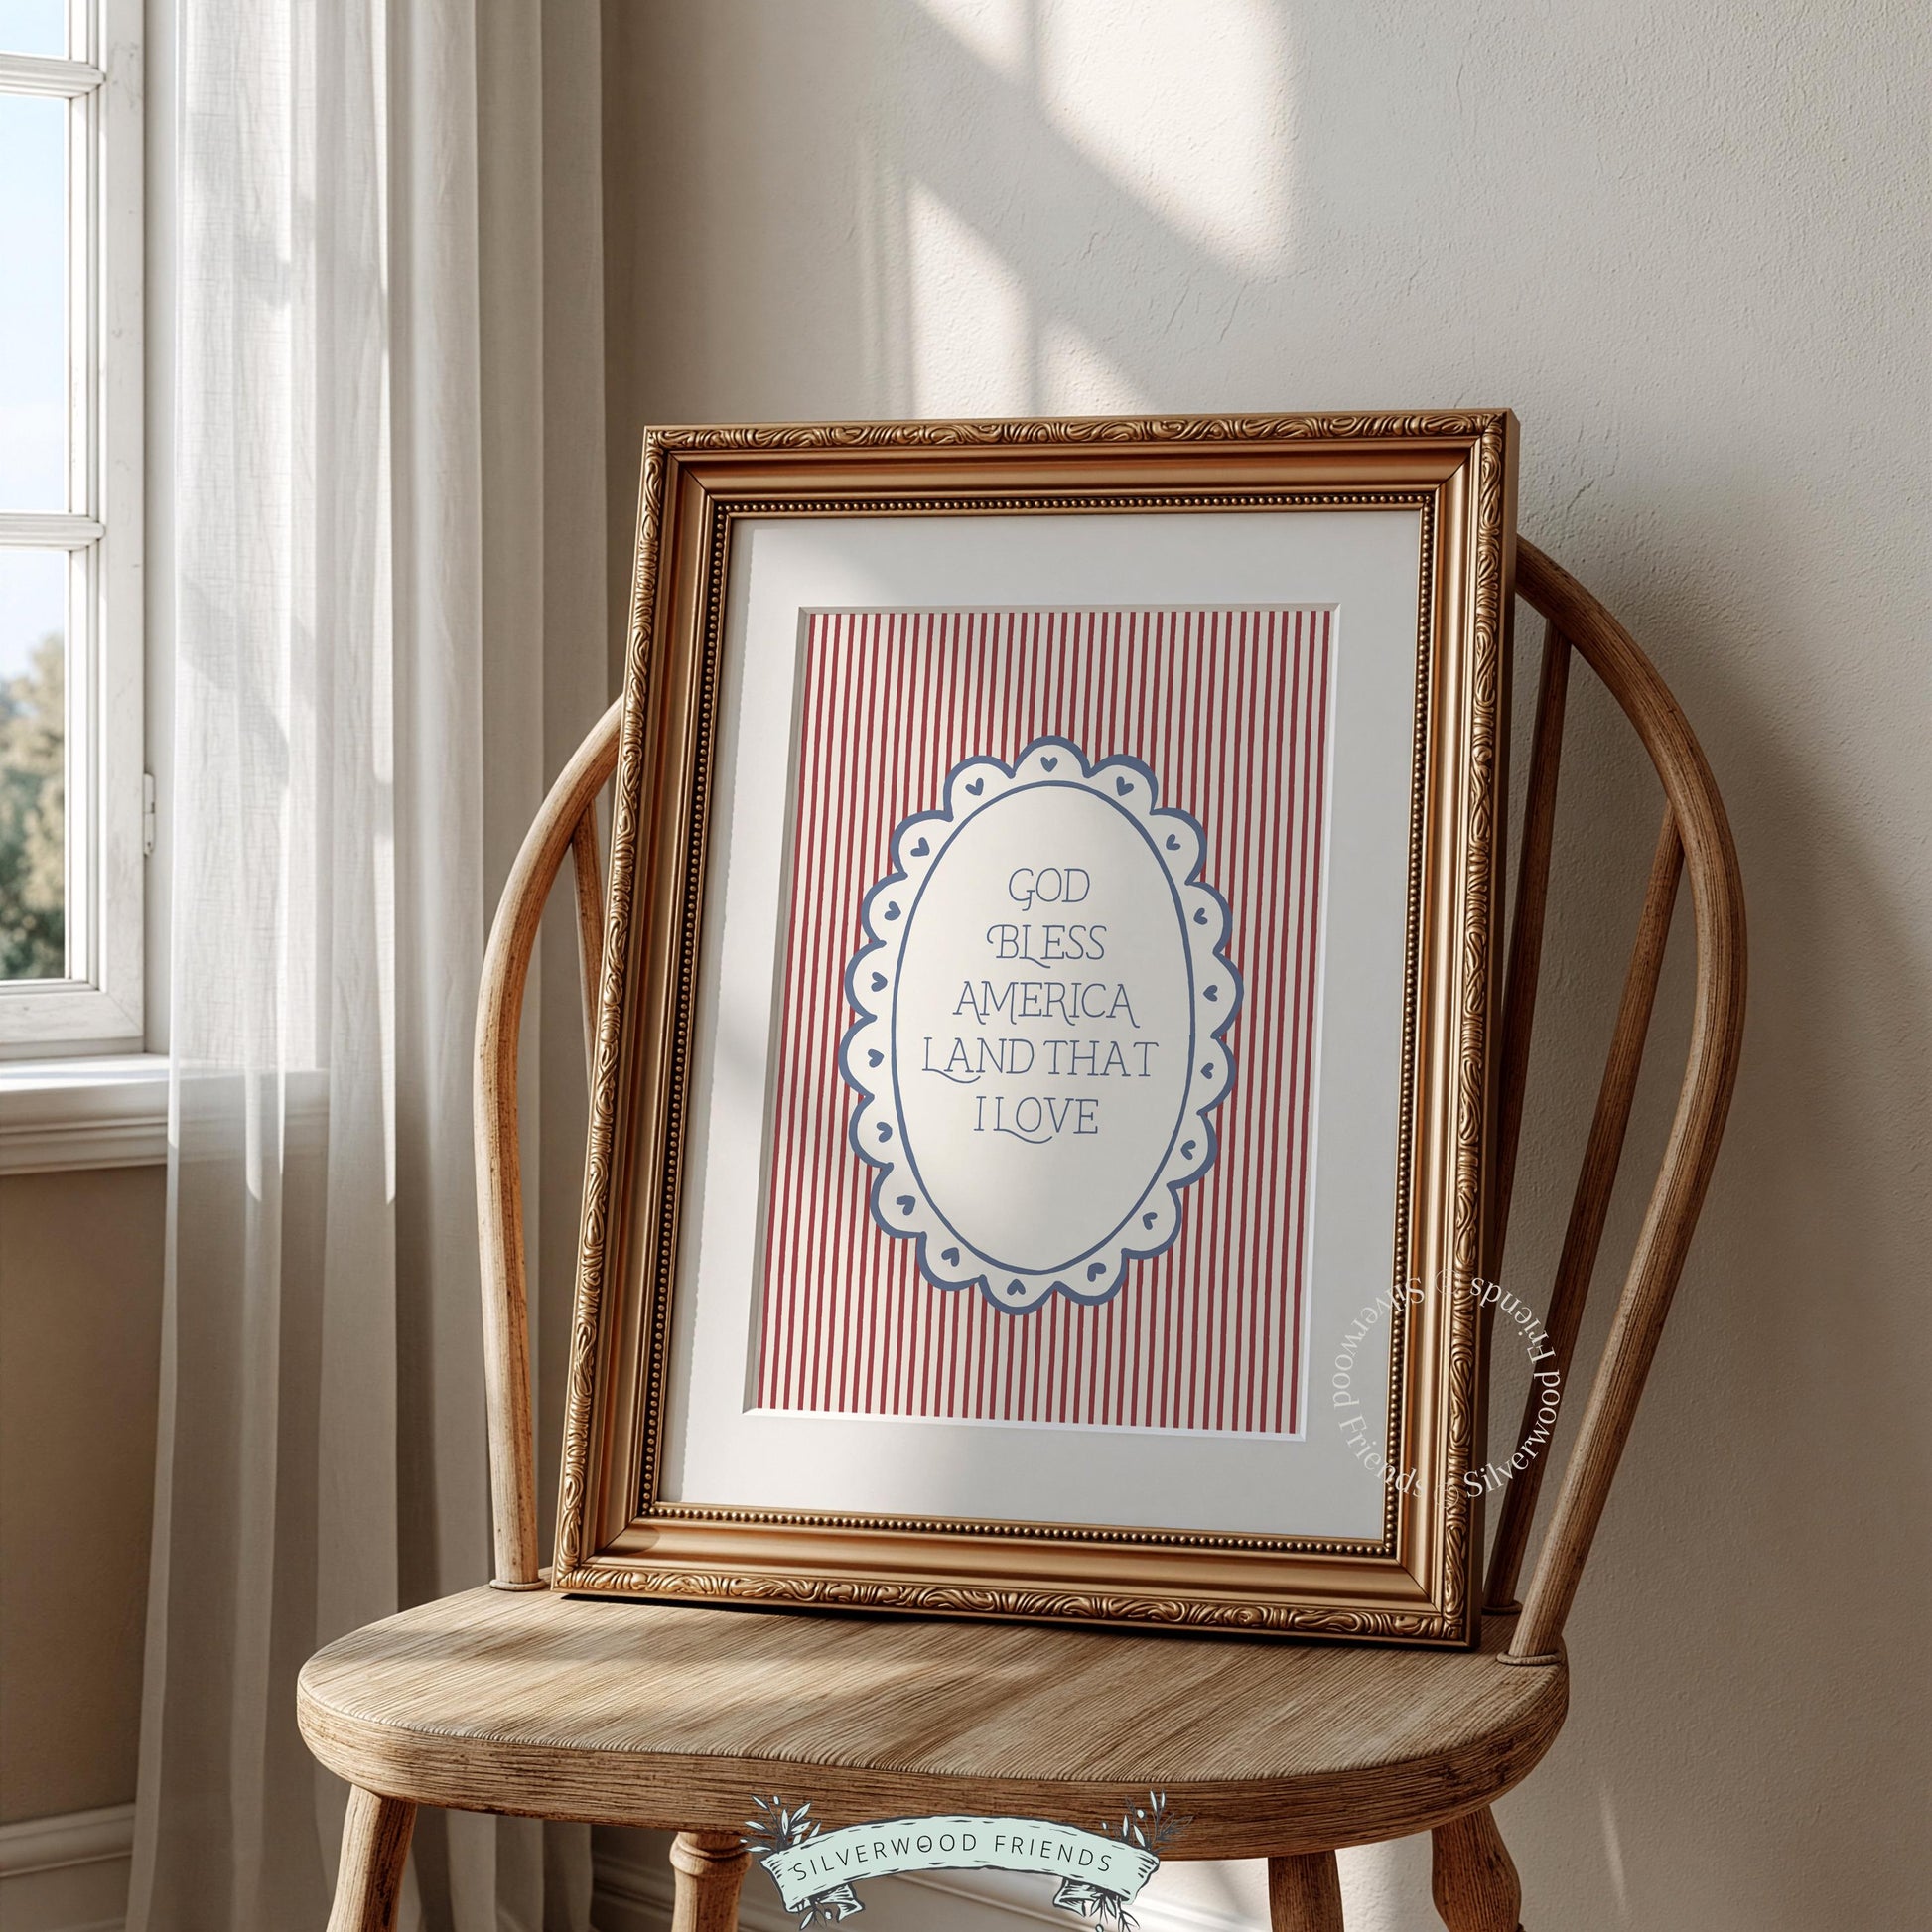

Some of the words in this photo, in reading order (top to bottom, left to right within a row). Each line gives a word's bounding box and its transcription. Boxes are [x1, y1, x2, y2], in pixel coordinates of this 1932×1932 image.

[1008, 867, 1090, 911] GOD
[986, 924, 1107, 969] BLESS
[952, 981, 1141, 1029] AMERICA
[921, 1037, 1035, 1084] LAND
[1043, 1040, 1160, 1077] THAT
[973, 1096, 987, 1131] I
[993, 1096, 1099, 1144] LOVE
